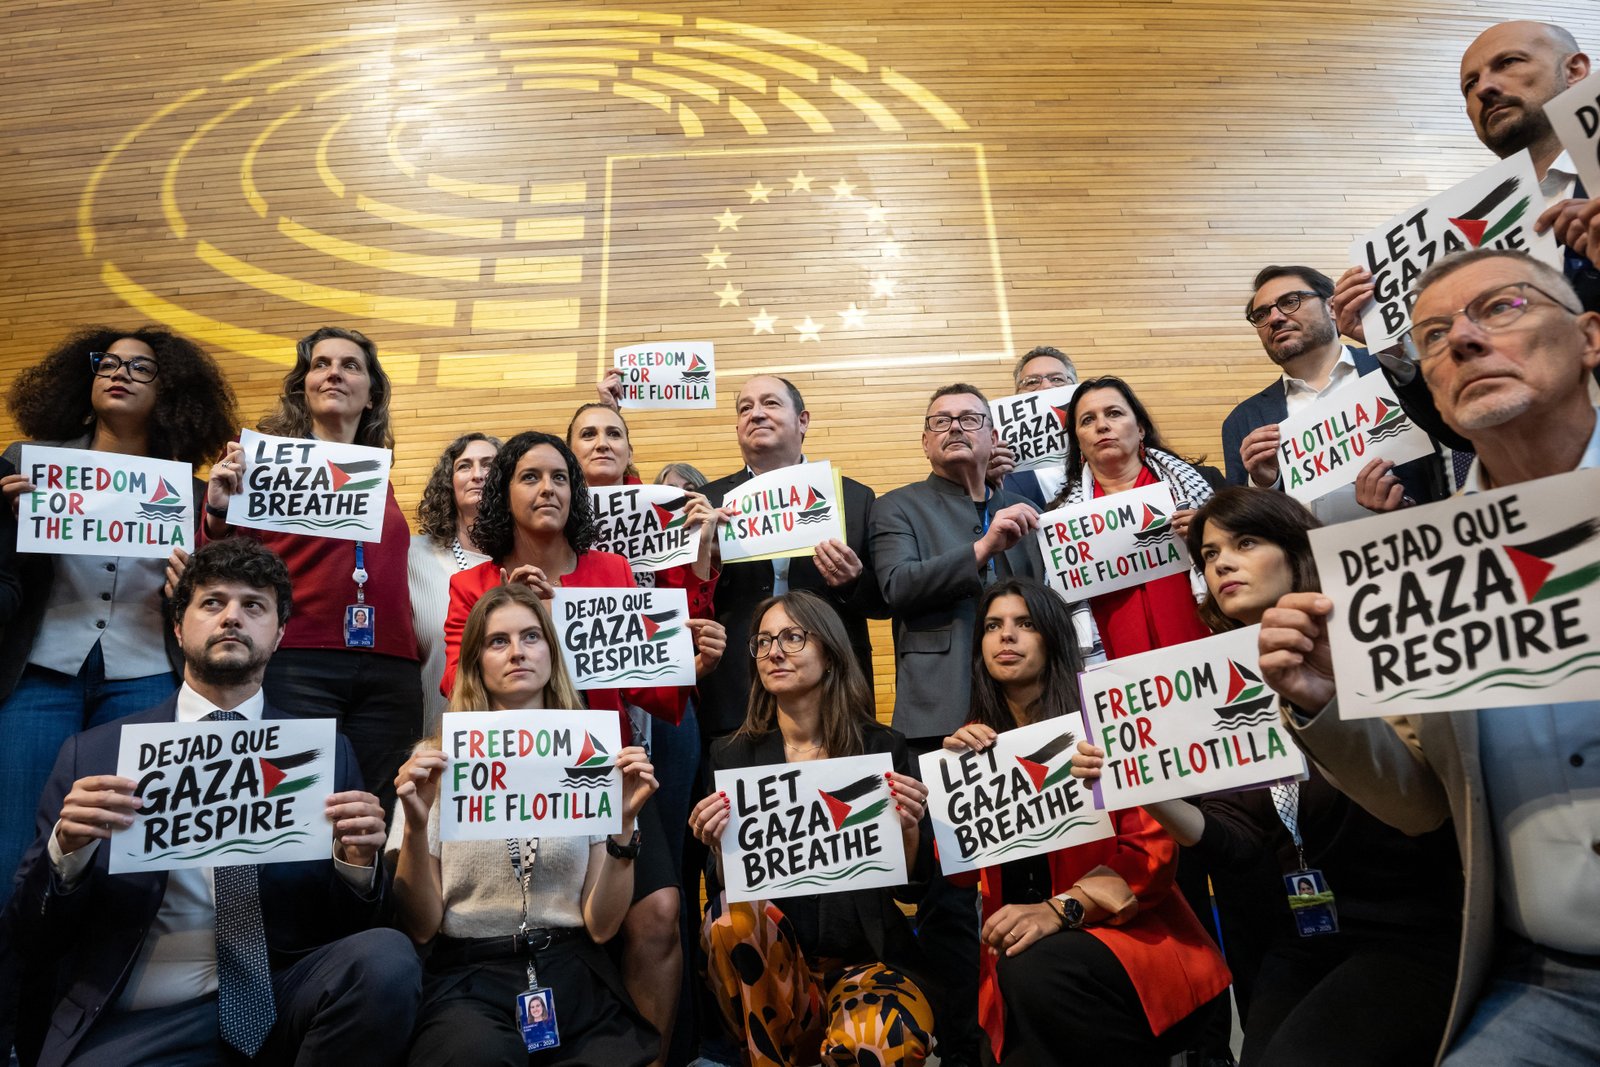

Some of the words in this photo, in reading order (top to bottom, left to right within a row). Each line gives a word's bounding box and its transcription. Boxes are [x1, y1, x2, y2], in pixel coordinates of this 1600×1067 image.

[1366, 207, 1429, 275] LET
[620, 352, 686, 367] FREEDOM
[620, 367, 650, 383] FOR
[622, 384, 645, 400] THE
[650, 384, 710, 400] FLOTILLA
[998, 396, 1039, 427] LET
[1002, 412, 1059, 445] GAZA
[1281, 403, 1370, 464] FLOTILLA
[254, 440, 316, 465] LET
[1291, 432, 1366, 490] ASKATU
[31, 463, 146, 495] FREEDOM
[248, 464, 330, 493] GAZA
[31, 491, 85, 516] FOR
[247, 492, 370, 518] BREATHE
[593, 489, 640, 519] LET
[725, 485, 801, 517] LOTILLA
[33, 516, 74, 540] THE
[82, 518, 185, 547] FLOTILLA
[596, 509, 659, 542] GAZA
[724, 511, 794, 542] ASKATU
[1043, 504, 1136, 547] FREEDOM
[1339, 523, 1443, 586] DEJAD
[1452, 494, 1527, 547] QUE
[1050, 541, 1095, 570] FOR
[1056, 565, 1093, 591] THE
[1095, 542, 1181, 582] FLOTILLA
[565, 596, 617, 621] DEJAD
[621, 592, 653, 611] QUE
[1348, 547, 1518, 643] GAZA
[564, 613, 644, 651] GAZA
[1368, 598, 1590, 693] RESPIRE
[574, 641, 671, 678] RESPIRE
[1093, 662, 1218, 723] FREEDOM
[138, 734, 223, 771] DEJAD
[231, 725, 280, 755] QUE
[453, 729, 572, 759] FREEDOM
[1101, 717, 1157, 758] FOR
[453, 761, 508, 792] FOR
[939, 743, 999, 794] LET
[1107, 754, 1154, 790] THE
[1158, 727, 1288, 780] FLOTILLA
[133, 757, 260, 816] GAZA
[735, 769, 802, 818] LET
[947, 767, 1030, 825] GAZA
[143, 797, 296, 854] RESPIRE
[452, 794, 496, 823] THE
[506, 791, 612, 822] FLOTILLA
[954, 779, 1084, 858] BREATHE
[738, 800, 829, 852] GAZA
[741, 823, 882, 888] BREATHE
[527, 1043, 540, 1051] 2024
